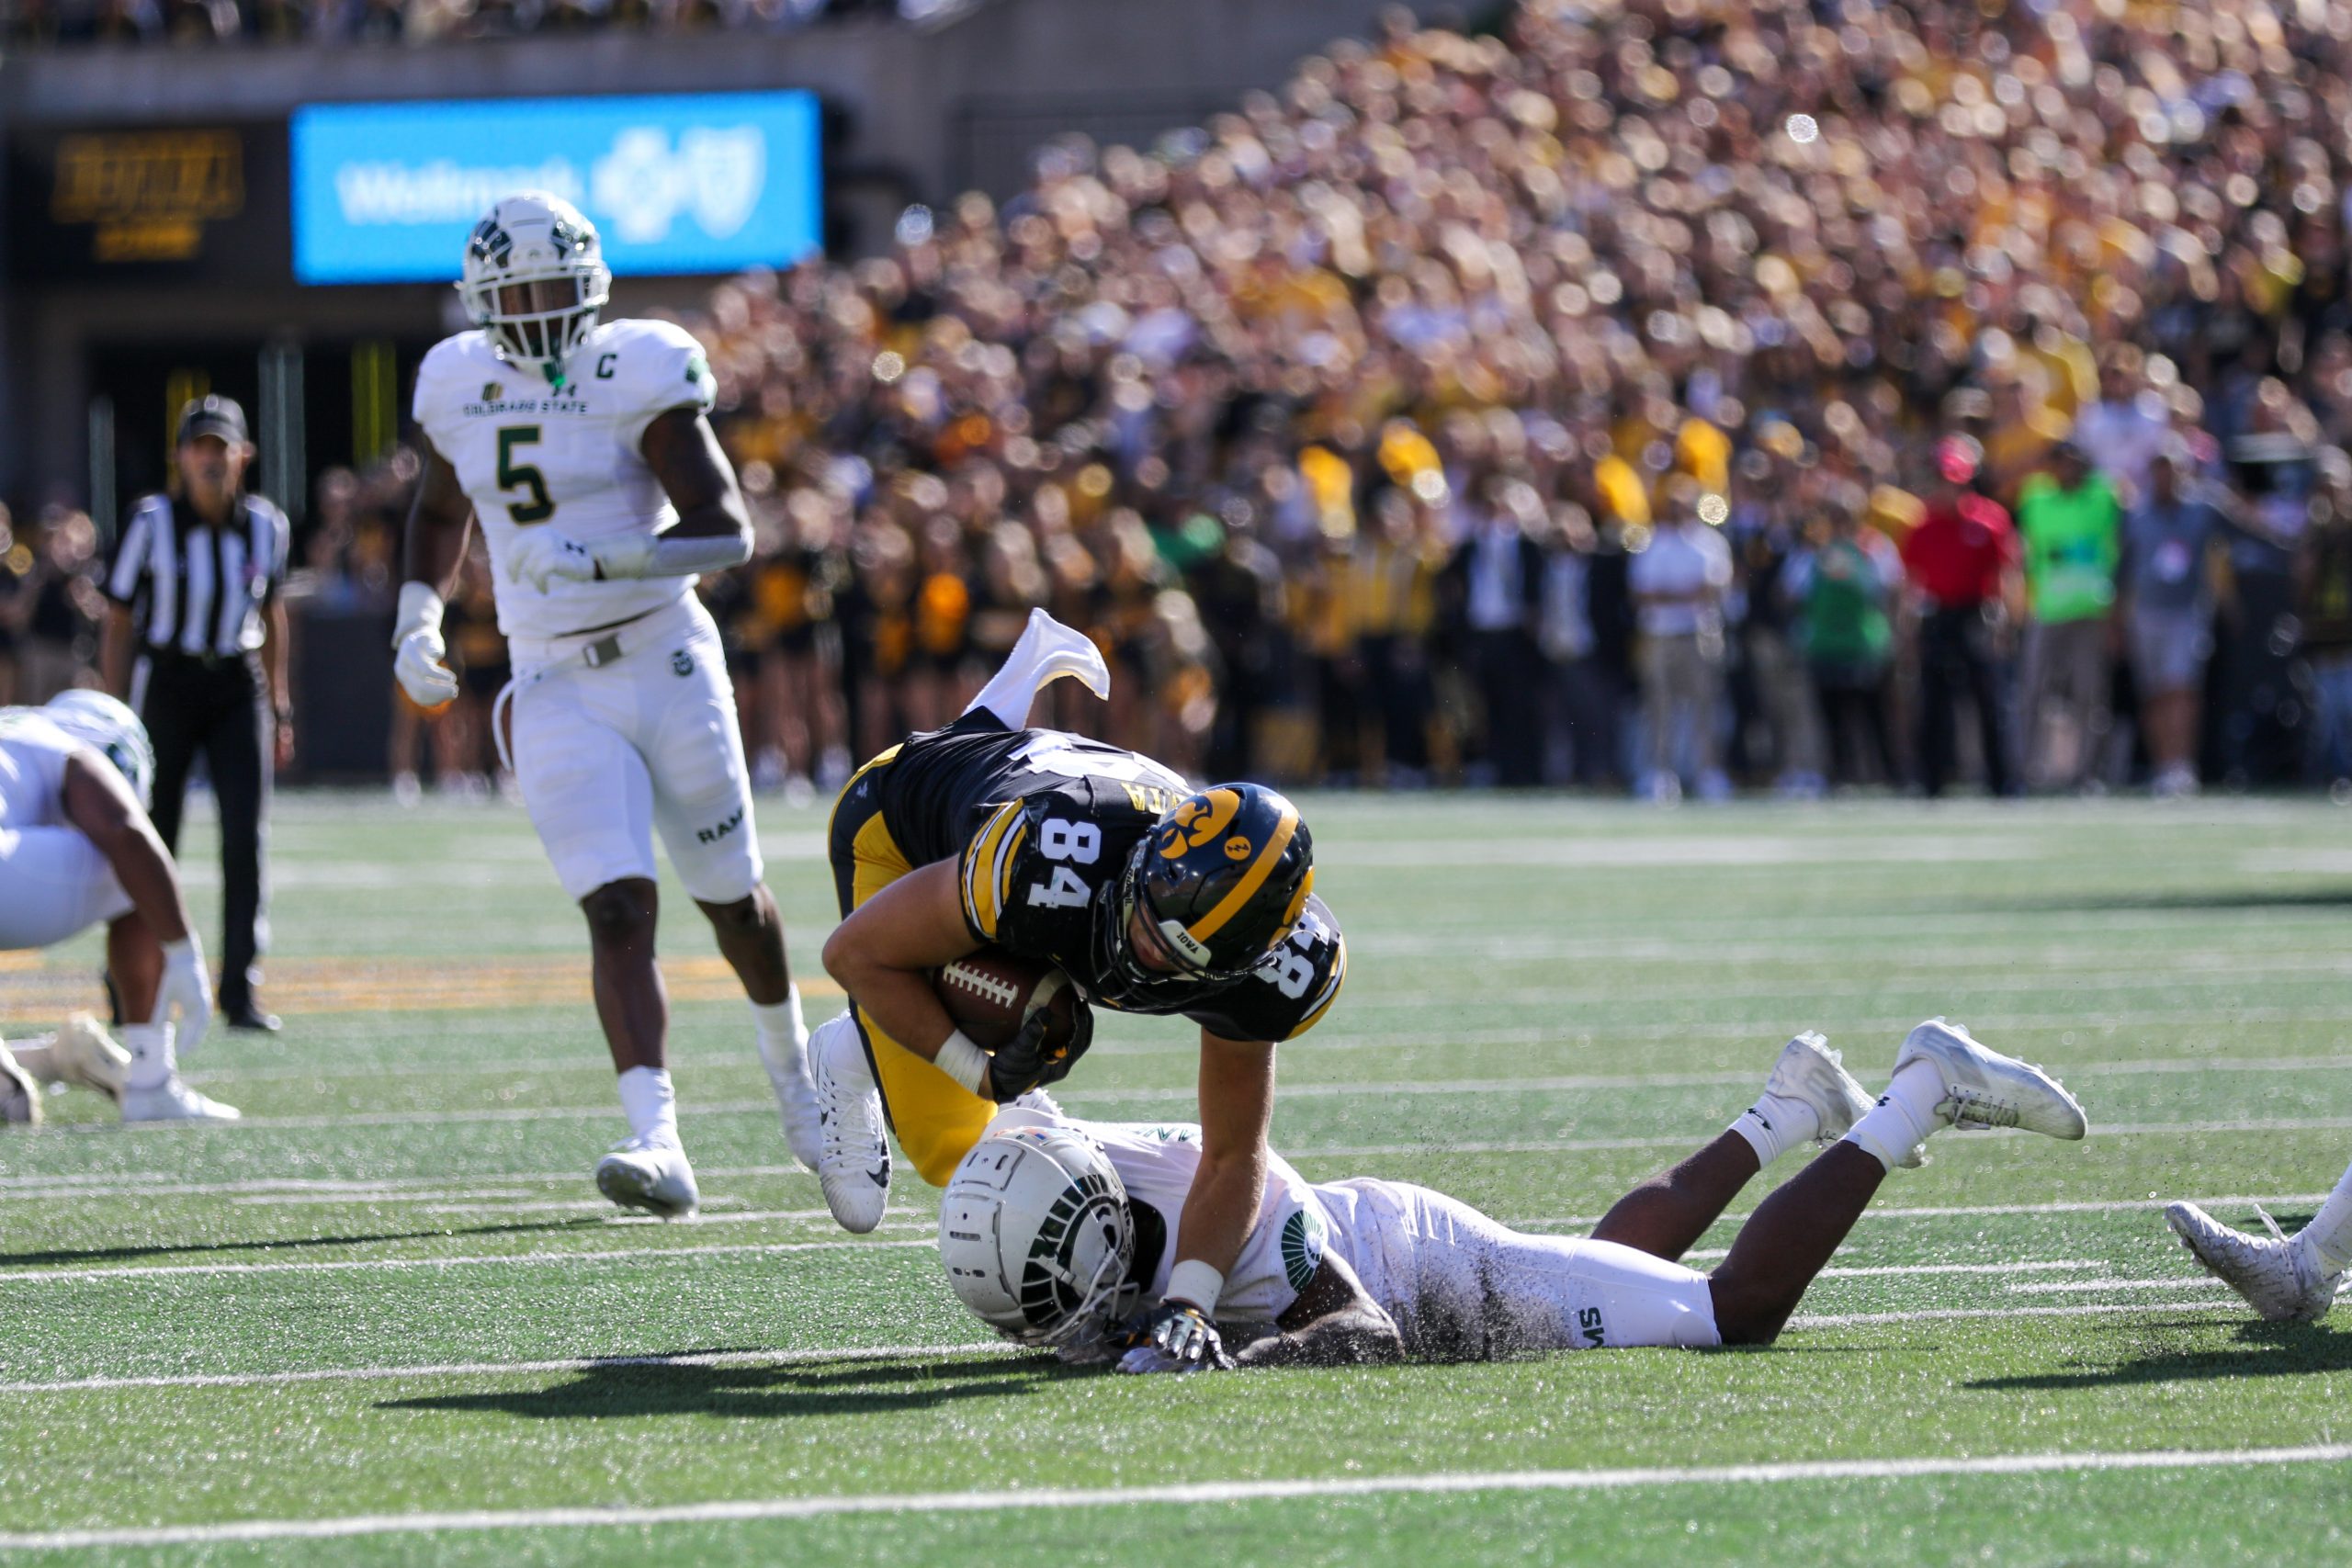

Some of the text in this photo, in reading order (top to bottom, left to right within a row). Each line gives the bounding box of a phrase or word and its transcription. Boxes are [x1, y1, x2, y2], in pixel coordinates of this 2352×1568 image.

[596, 354, 617, 379] C
[542, 400, 587, 414] STATE
[497, 424, 556, 529] 5
[1026, 818, 1102, 909] 84
[1176, 931, 1199, 954] IOWA
